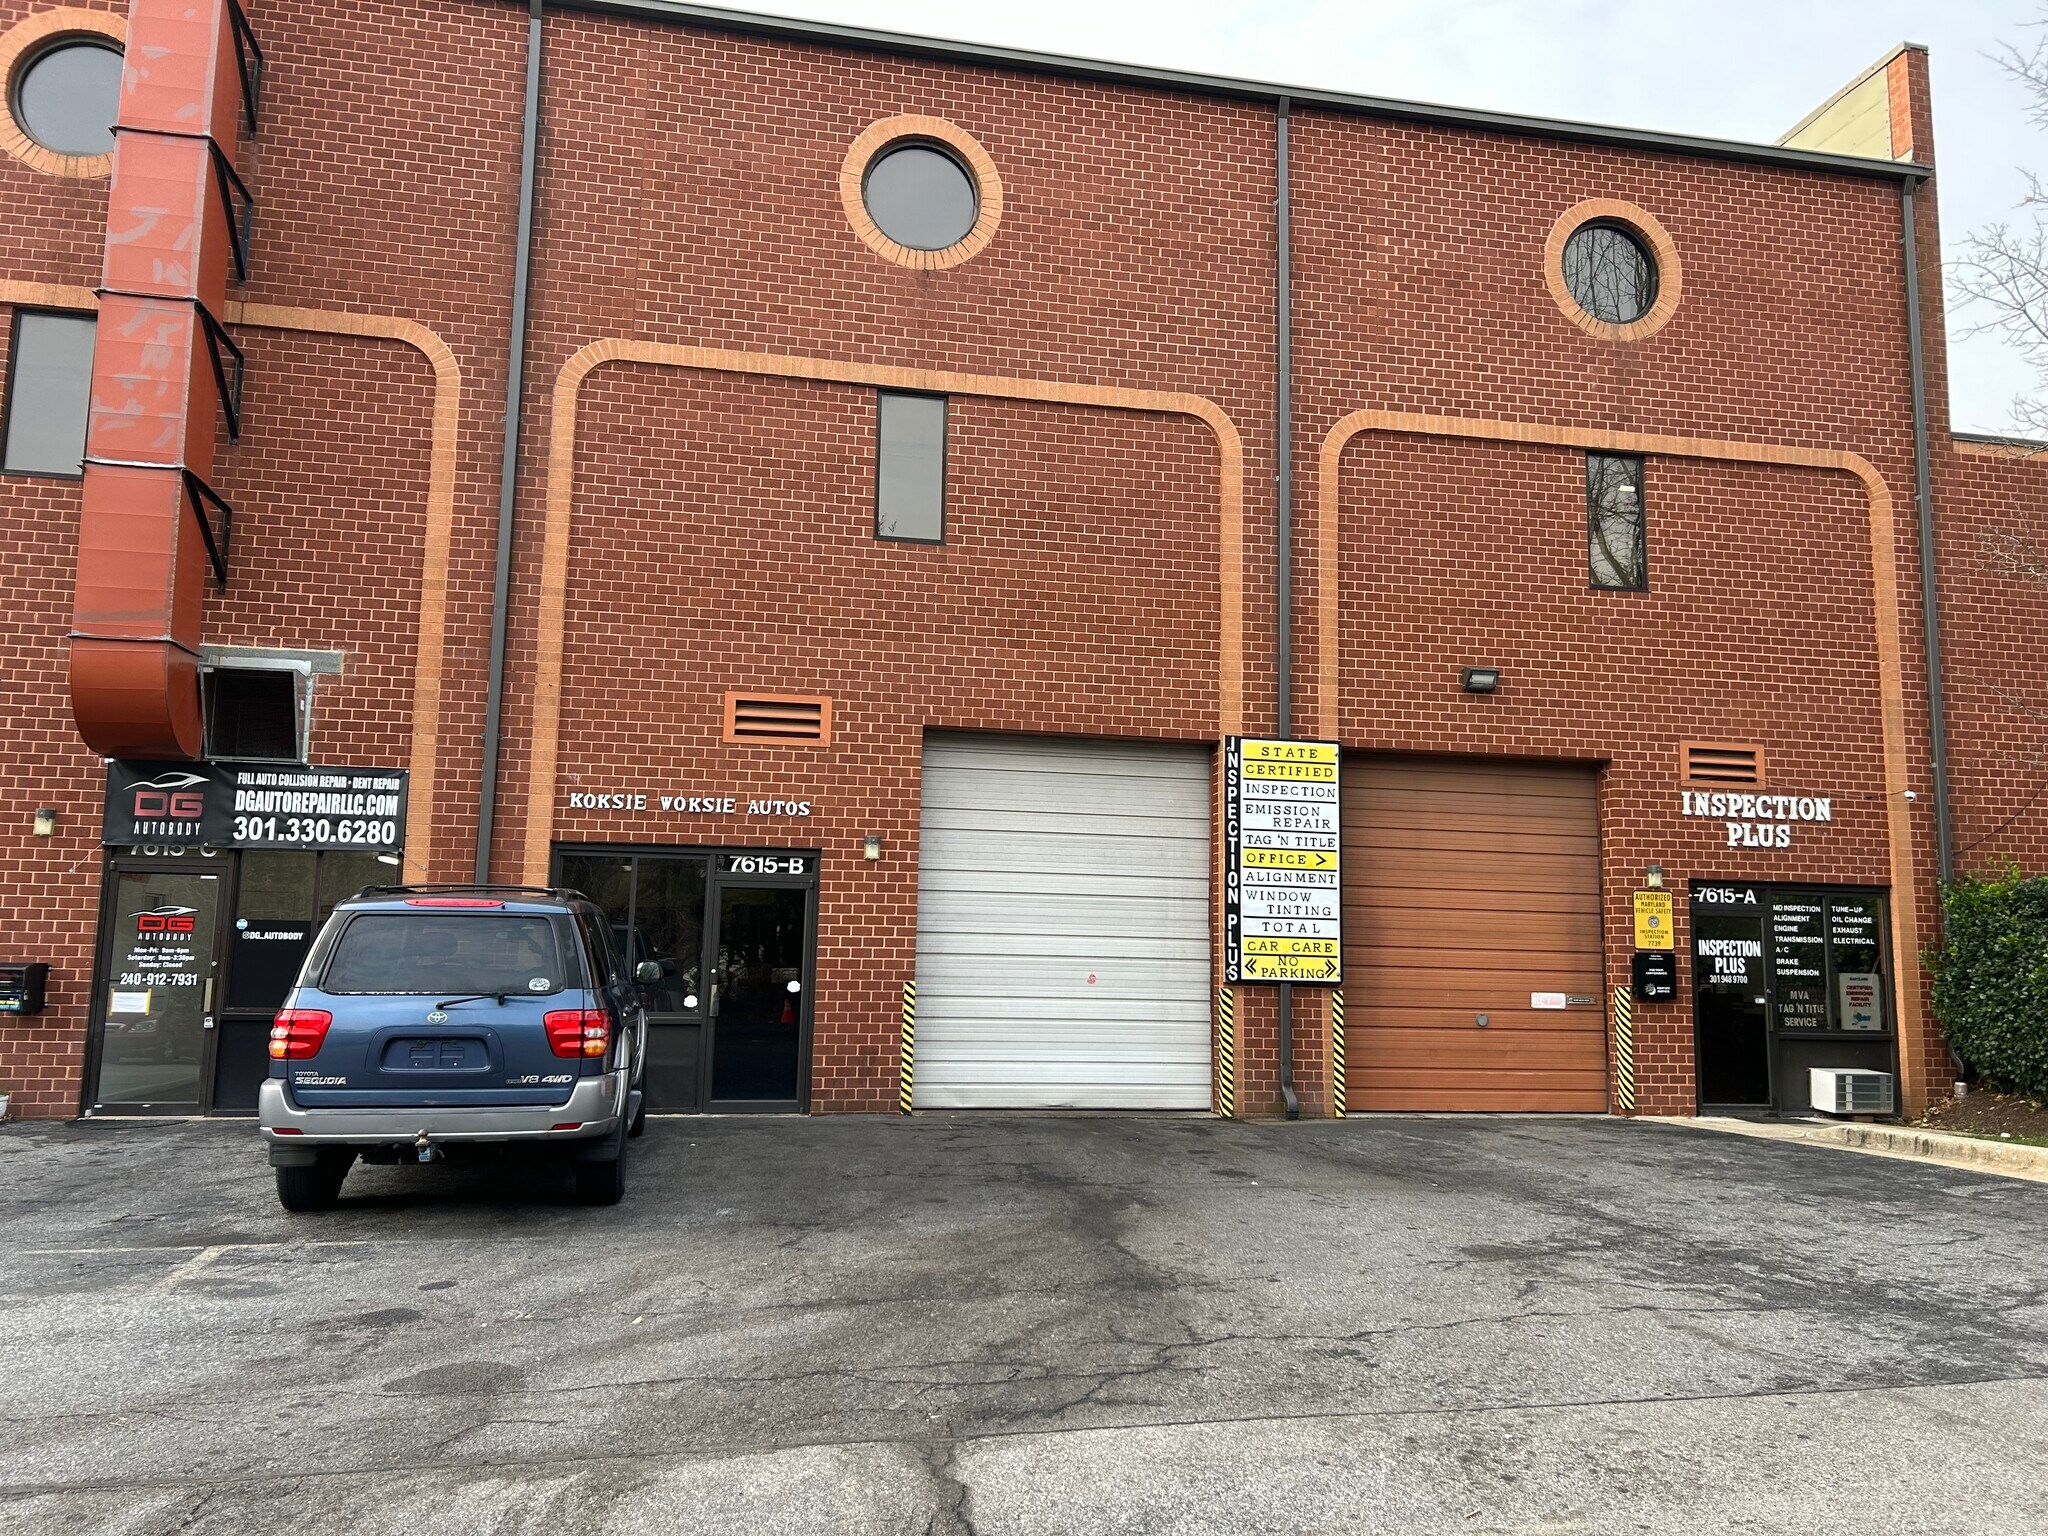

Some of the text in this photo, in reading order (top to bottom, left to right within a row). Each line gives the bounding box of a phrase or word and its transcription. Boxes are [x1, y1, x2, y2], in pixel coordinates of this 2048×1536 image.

[1261, 746, 1318, 759] STATE
[1245, 764, 1333, 778] CERTIFIED
[237, 772, 400, 790] FULL AUTO COLLISION REPAIR DENT REPAIR
[1245, 783, 1335, 798] INSPECTION
[134, 791, 204, 817] DG
[234, 790, 399, 816] DGAUTOREPAIRLLC.COM
[570, 792, 811, 816] KOKSIE WOKSIE AUTOS
[1680, 792, 1832, 822] INSPECTION
[1245, 804, 1320, 817] EMISSION
[133, 821, 201, 835] AUTOBODY
[232, 816, 396, 844] 301.330.6280
[1273, 818, 1331, 829] REPAIR
[1246, 834, 1272, 846] TAG
[1295, 837, 1336, 848] TITLE
[1726, 822, 1791, 848] PLUS
[729, 855, 804, 875] 7615-B
[1227, 737, 1239, 981] INSPECTION PLUS
[1246, 853, 1307, 865] OFFICE
[1245, 871, 1337, 885] ALIGNMENT
[1246, 889, 1312, 902] WINDOW
[1635, 894, 1671, 902] AUTHORIZED
[1696, 887, 1757, 904] 7615-A
[1267, 905, 1331, 917] TINTING
[1831, 905, 1863, 913] TUNE-UP
[137, 916, 195, 931] DG
[1773, 914, 1810, 922] ALIGNMENT
[1844, 916, 1872, 924] CHANGE
[1262, 922, 1321, 935] TOTAL
[137, 933, 193, 941] AUTOBODY
[1247, 941, 1333, 953] CAR CARE
[1698, 939, 1761, 957] INSPECTION
[1278, 956, 1299, 967] NO
[1715, 957, 1746, 974] PLUS
[119, 972, 198, 985] 240-912-7931
[1261, 967, 1326, 979] PARKING
[1709, 974, 1721, 983] 301
[1733, 975, 1748, 984] 9700
[1790, 991, 1810, 1000] MVA
[1778, 1004, 1794, 1013] TAG
[1805, 1004, 1824, 1014] TITLE
[1784, 1017, 1817, 1027] SERVICE
[295, 1077, 346, 1085] SEQUOIA
[520, 1075, 540, 1083] V8
[541, 1074, 573, 1083] 4WD
